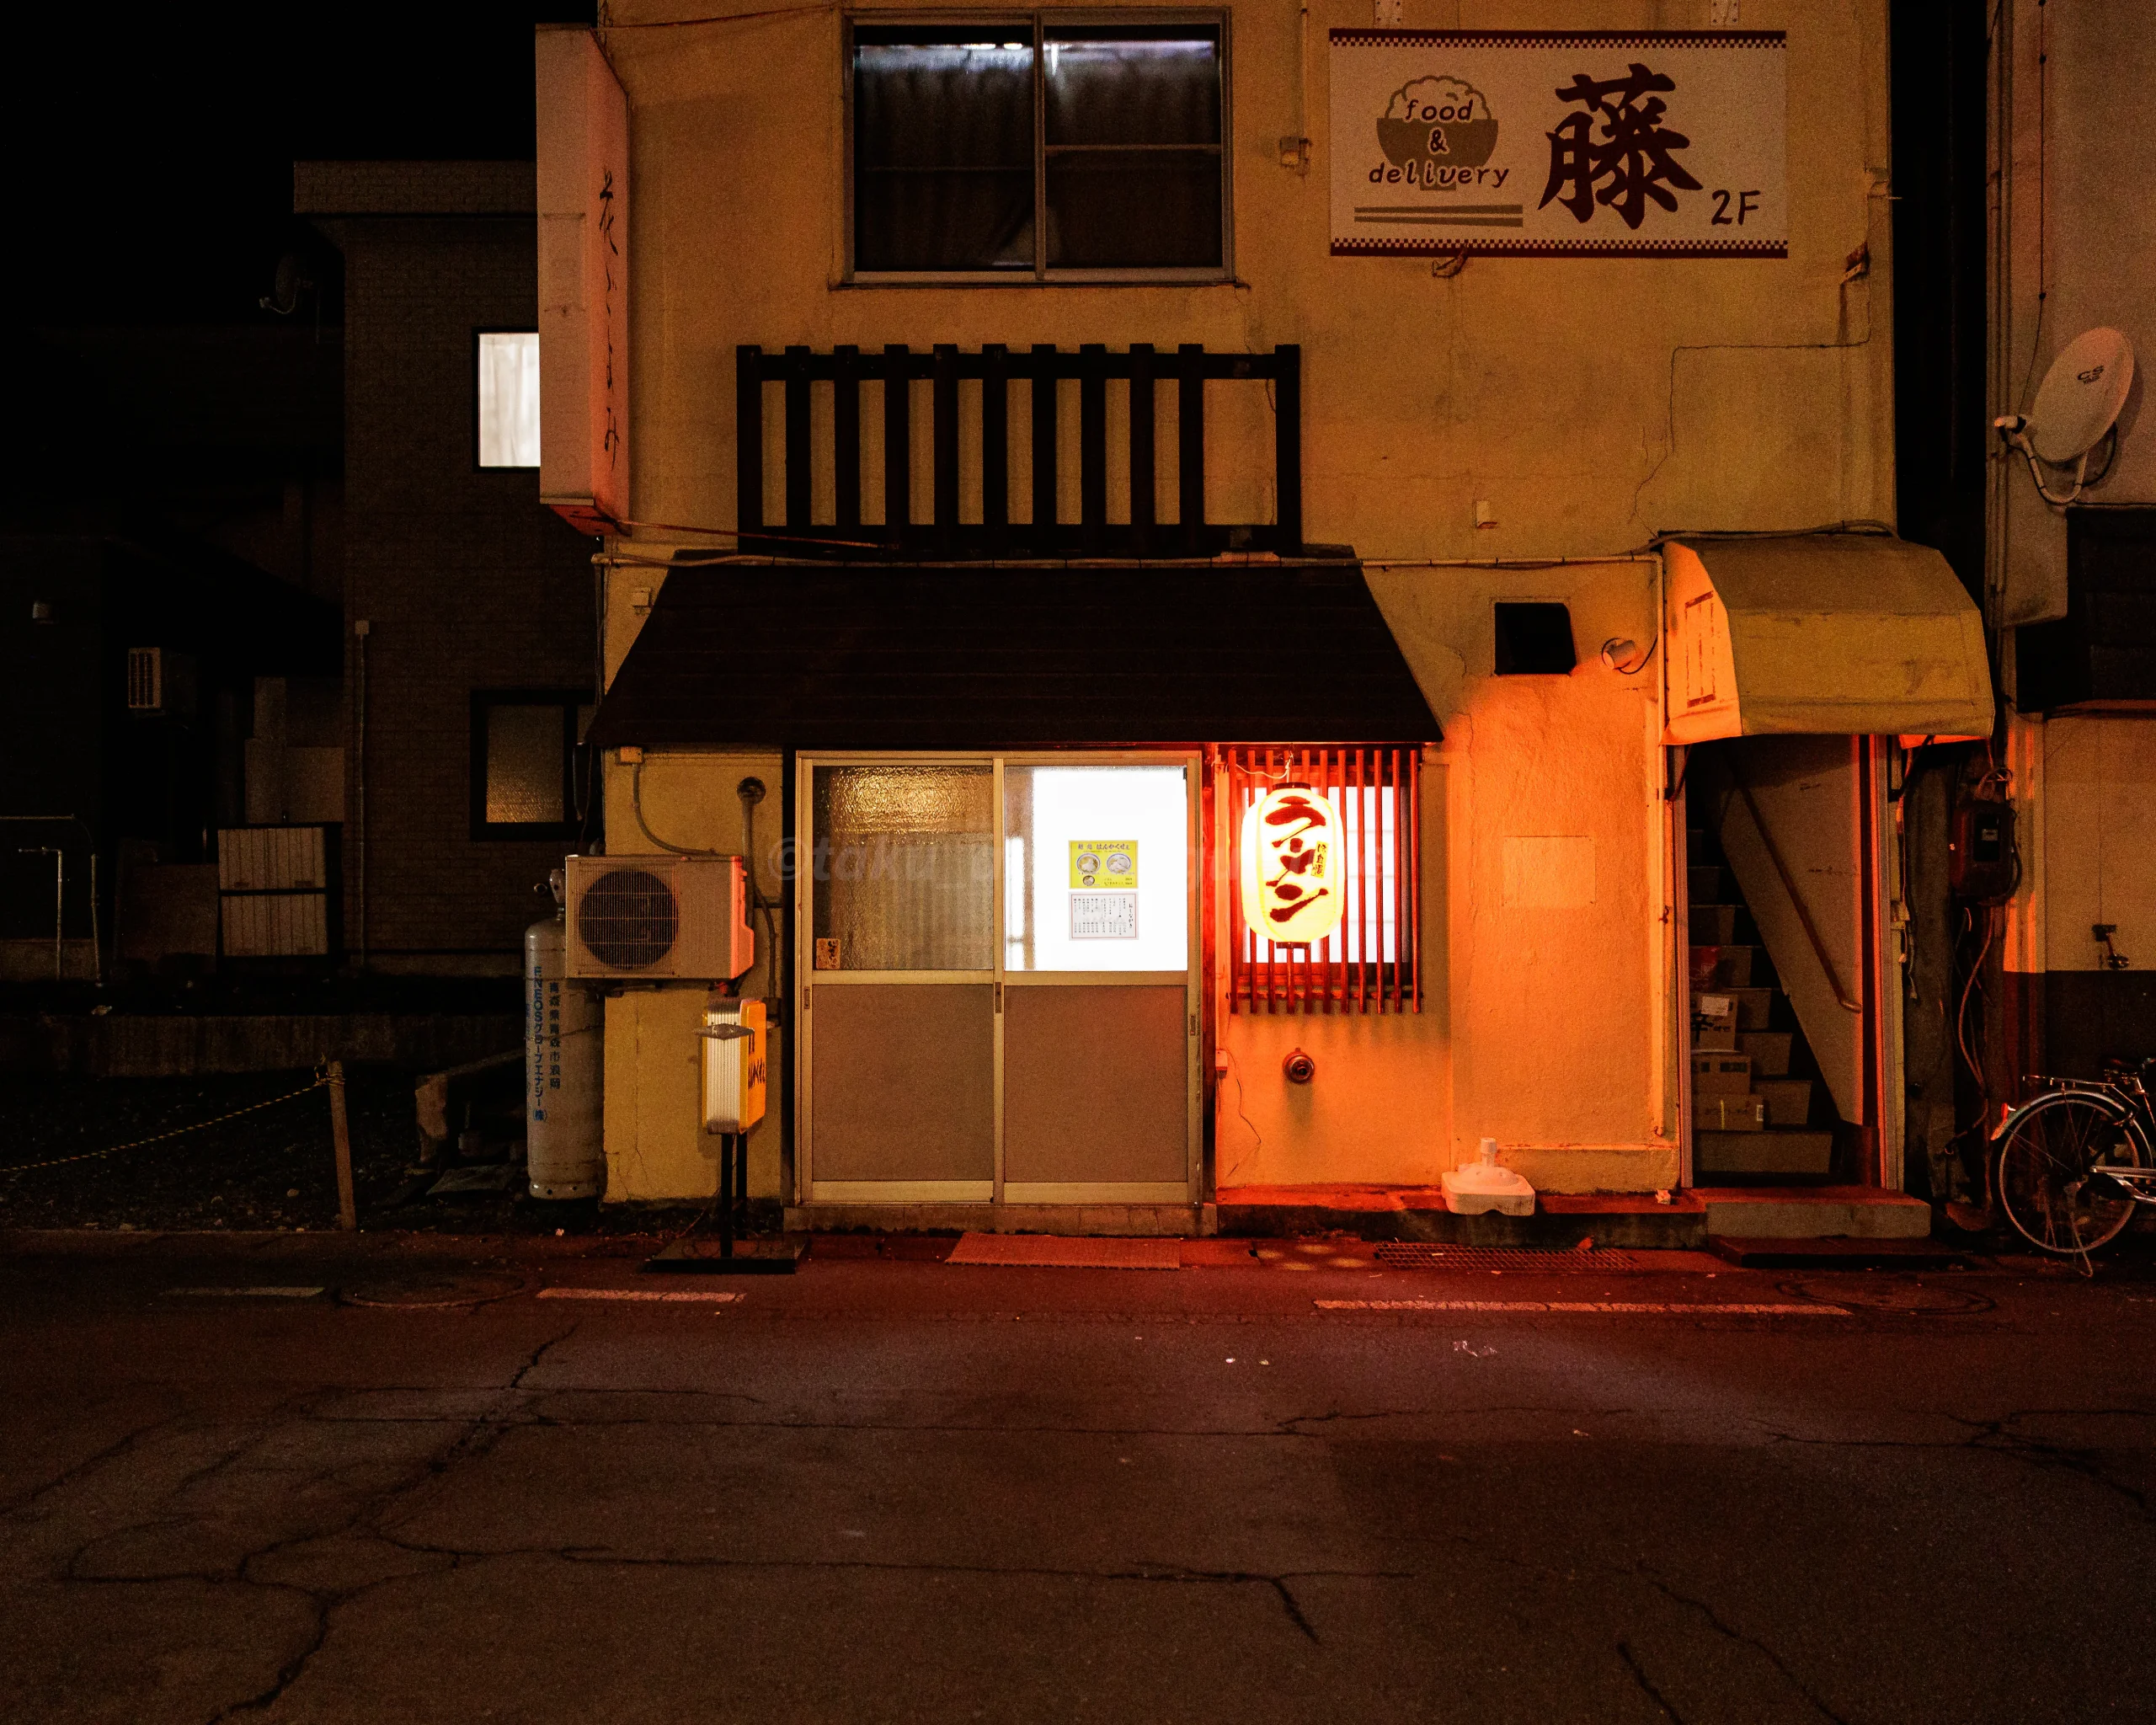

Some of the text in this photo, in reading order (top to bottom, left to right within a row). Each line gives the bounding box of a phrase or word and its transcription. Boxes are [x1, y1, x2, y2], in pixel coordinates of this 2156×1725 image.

[1405, 99, 1475, 122] food
[1428, 128, 1448, 153] &
[1537, 62, 1704, 230] 藤
[1368, 161, 1511, 189] delivery
[1710, 189, 1762, 226] 2F
[2077, 365, 2104, 380] CS
